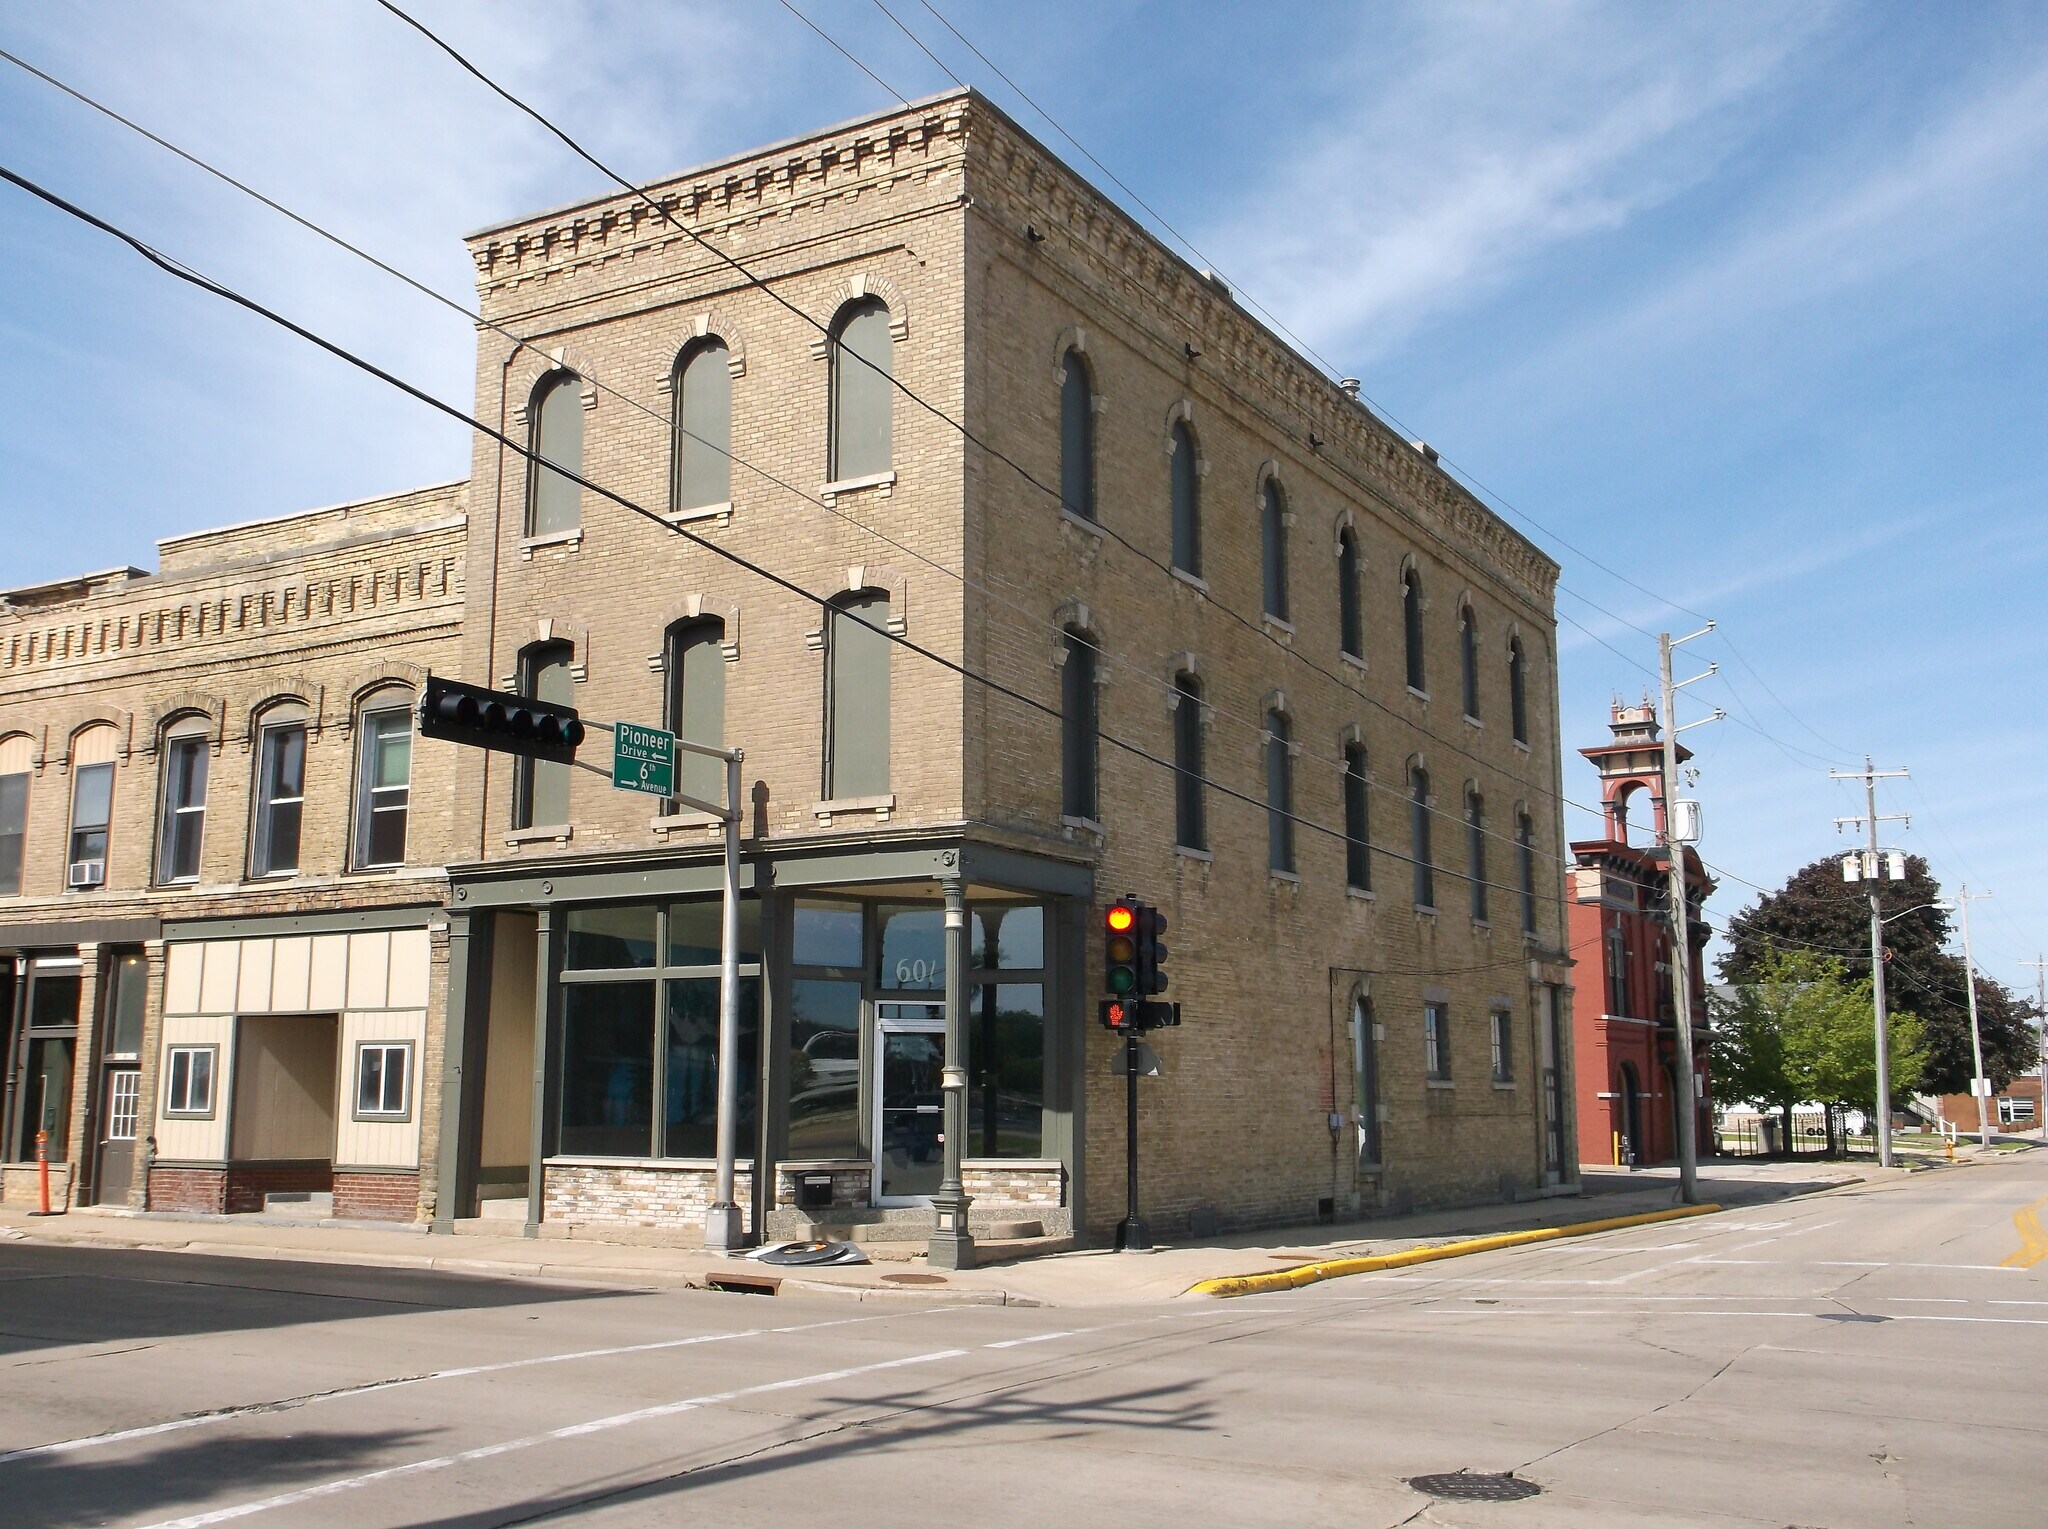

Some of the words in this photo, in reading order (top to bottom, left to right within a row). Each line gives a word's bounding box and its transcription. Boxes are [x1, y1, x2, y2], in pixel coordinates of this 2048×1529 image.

[620, 725, 670, 751] Pioneer
[621, 744, 648, 758] Drive
[640, 762, 656, 780] 6th
[641, 780, 667, 794] Avenue
